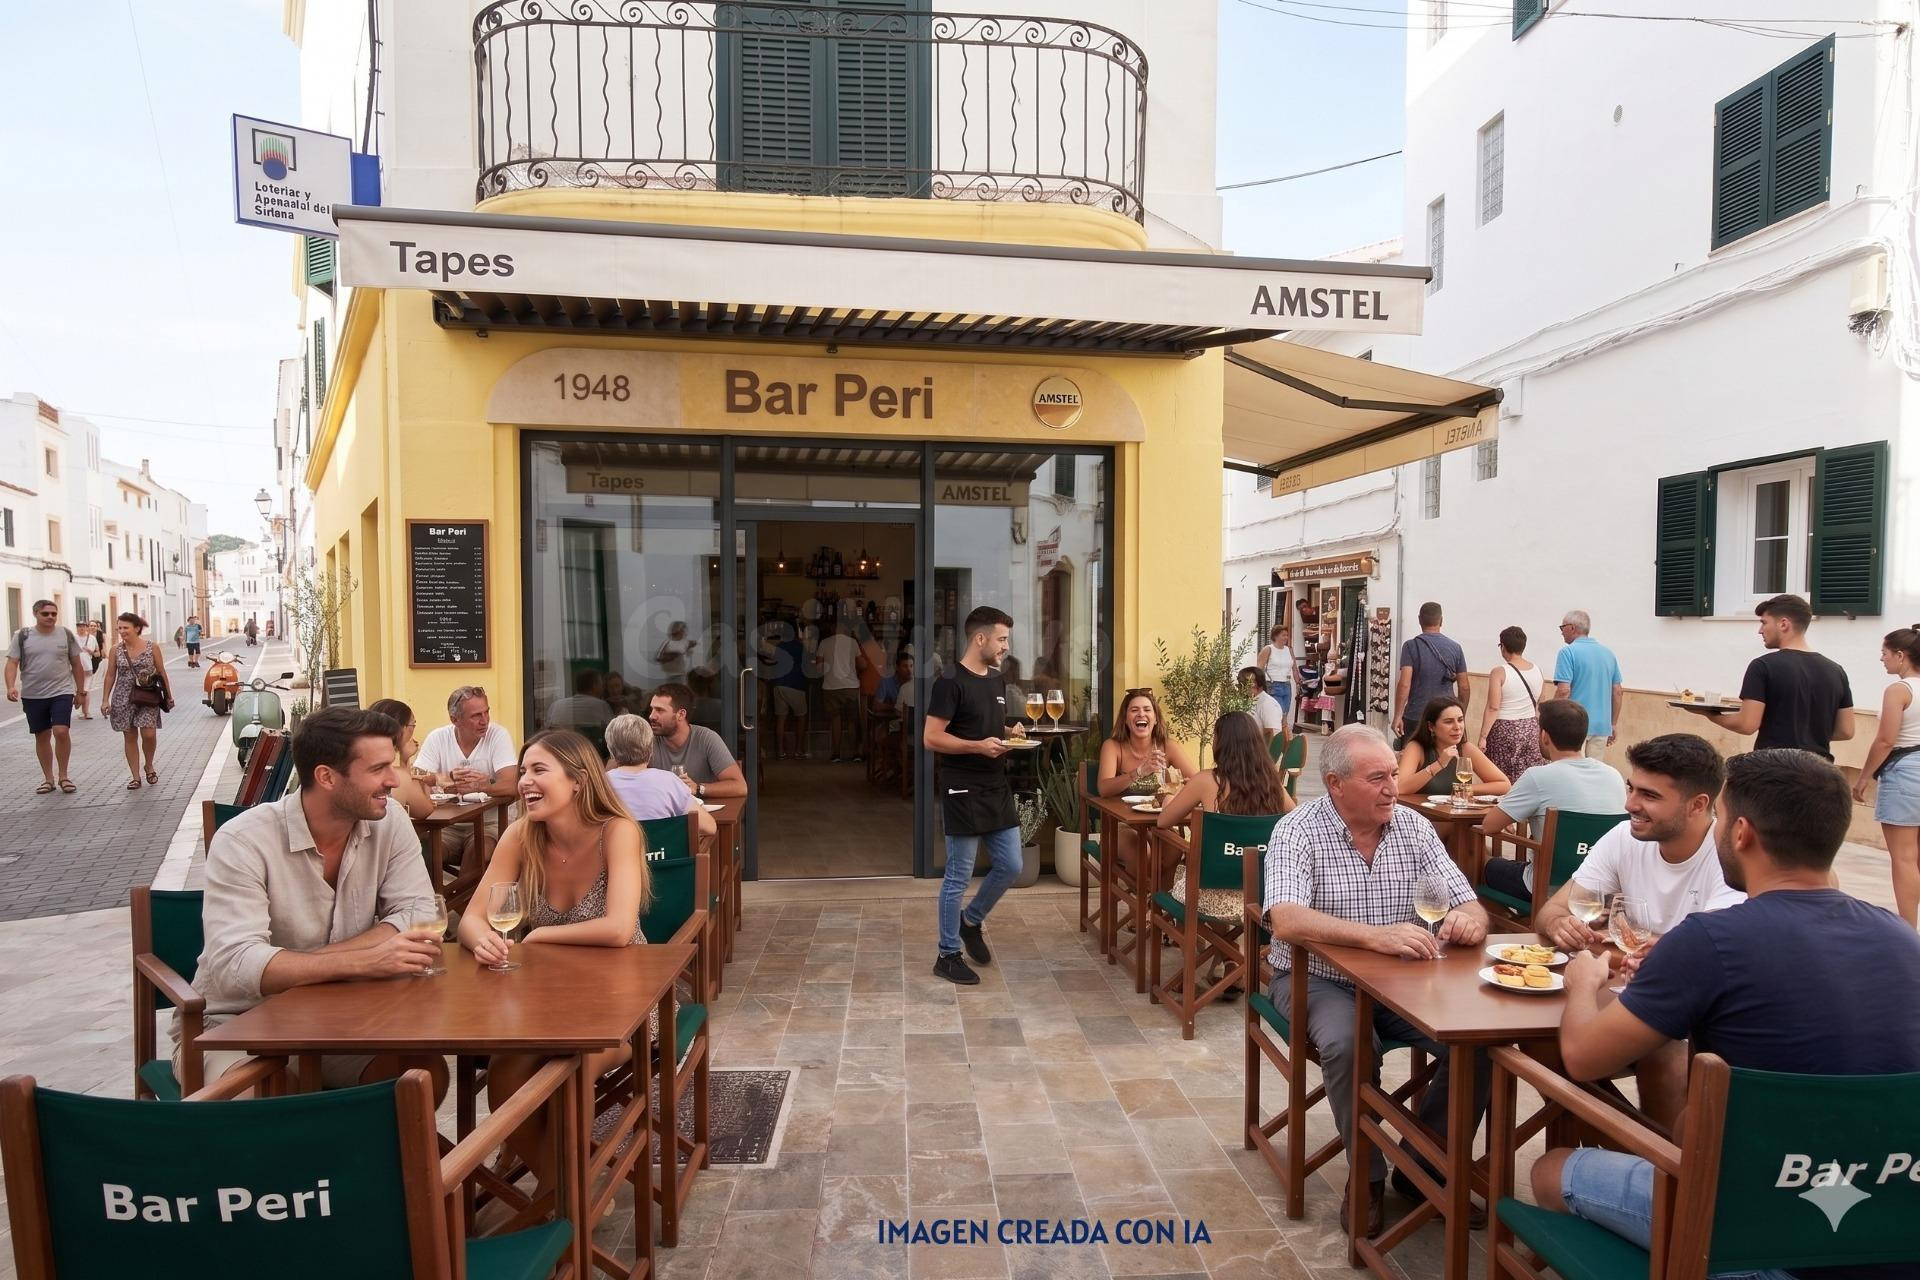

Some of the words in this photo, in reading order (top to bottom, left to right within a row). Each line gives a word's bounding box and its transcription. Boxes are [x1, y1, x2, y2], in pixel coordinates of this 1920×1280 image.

[304, 191, 312, 202] y
[313, 203, 330, 215] del
[389, 240, 515, 283] Tapes
[1250, 285, 1389, 321] AMSTEL
[553, 373, 631, 402] 1948
[725, 369, 818, 415] Bar
[834, 373, 933, 419] Peri
[1038, 393, 1079, 404] AMSTEL
[586, 471, 645, 491] Tapes
[941, 485, 1012, 501] AMSTEL
[429, 527, 446, 536] Bar
[1223, 842, 1244, 856] Ba
[1774, 1153, 1868, 1188] Bar
[102, 1183, 198, 1223] Bar
[217, 1179, 332, 1223] Peri
